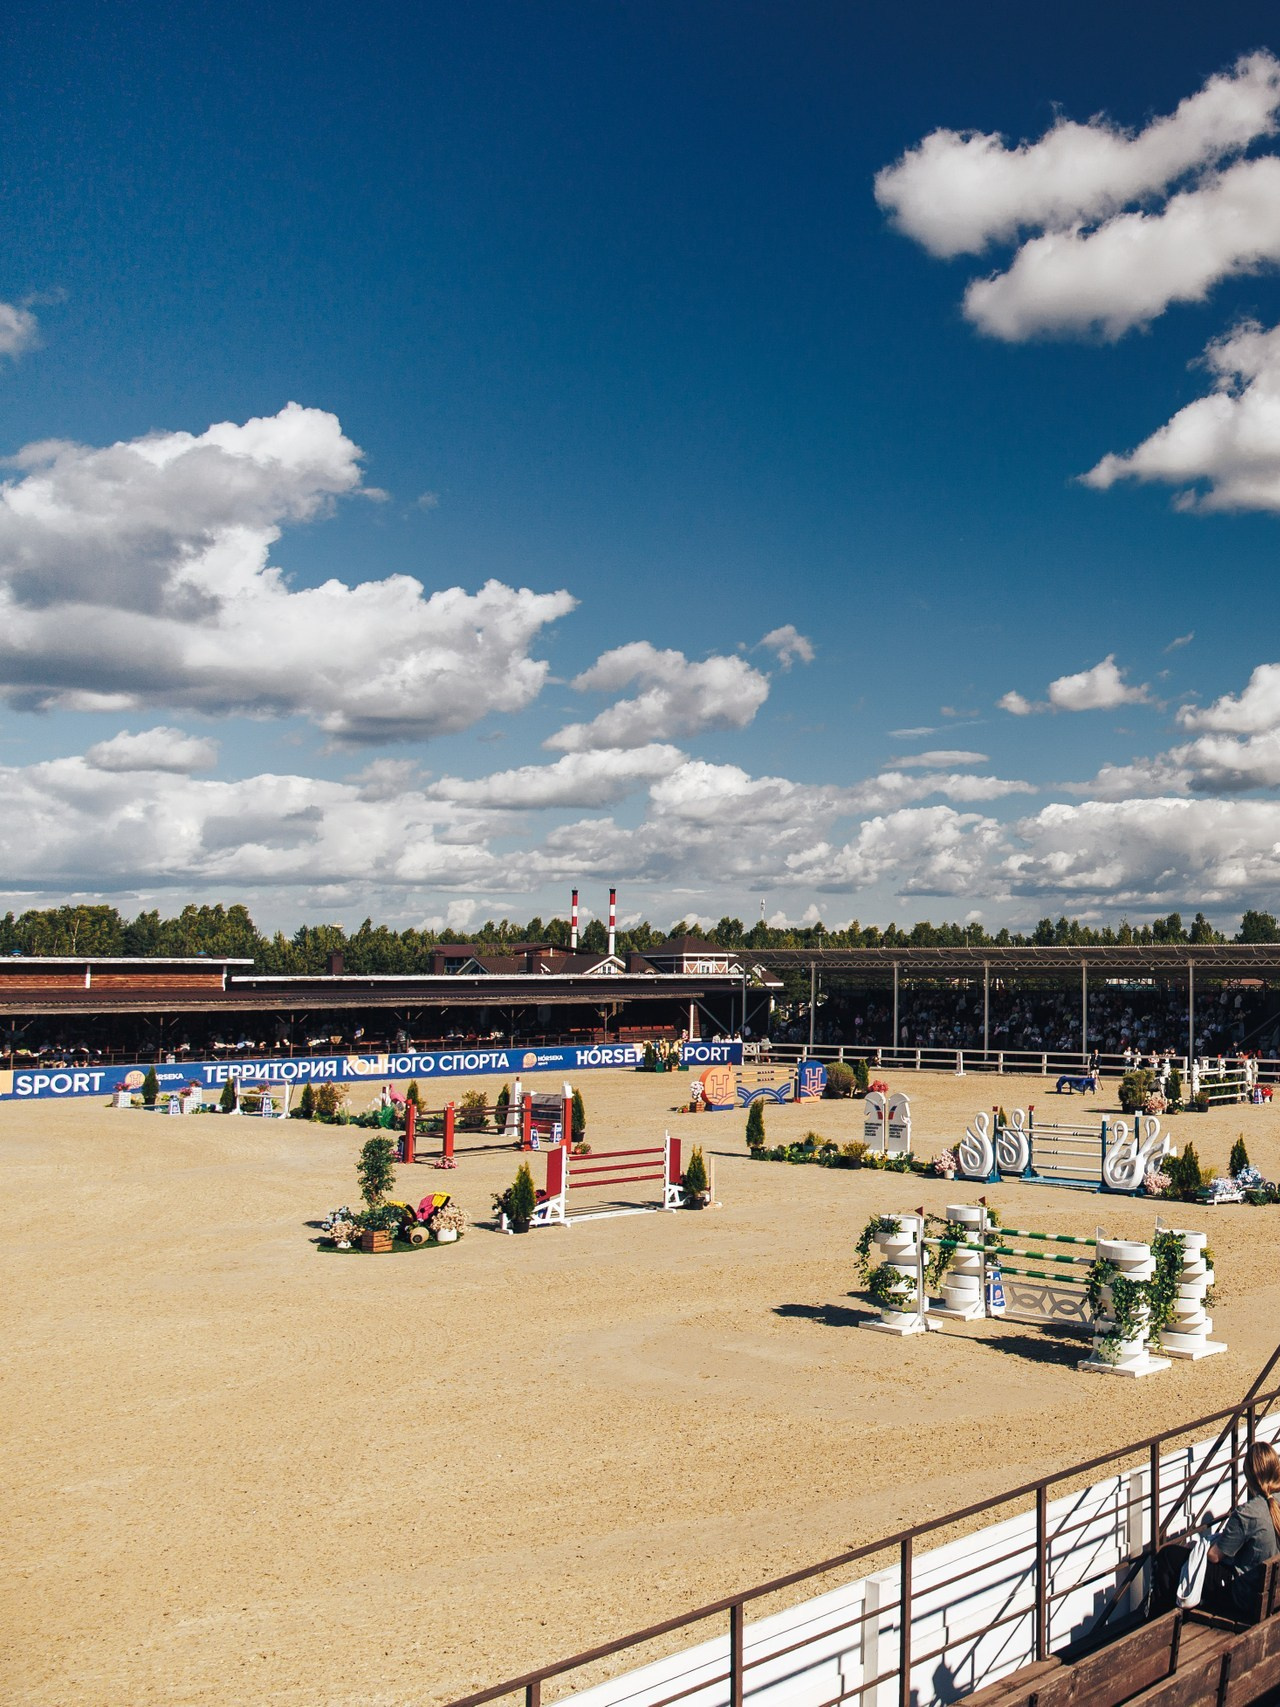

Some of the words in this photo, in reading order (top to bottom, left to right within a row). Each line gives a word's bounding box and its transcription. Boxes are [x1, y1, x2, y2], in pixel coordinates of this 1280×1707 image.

[577, 1046, 661, 1064] HÓRSEK
[203, 1060, 337, 1084] ТЕРРИТОРИЯ
[342, 1056, 436, 1077] КОННОГО
[438, 1053, 510, 1072] СПОРТА
[15, 1072, 106, 1096] SPORT
